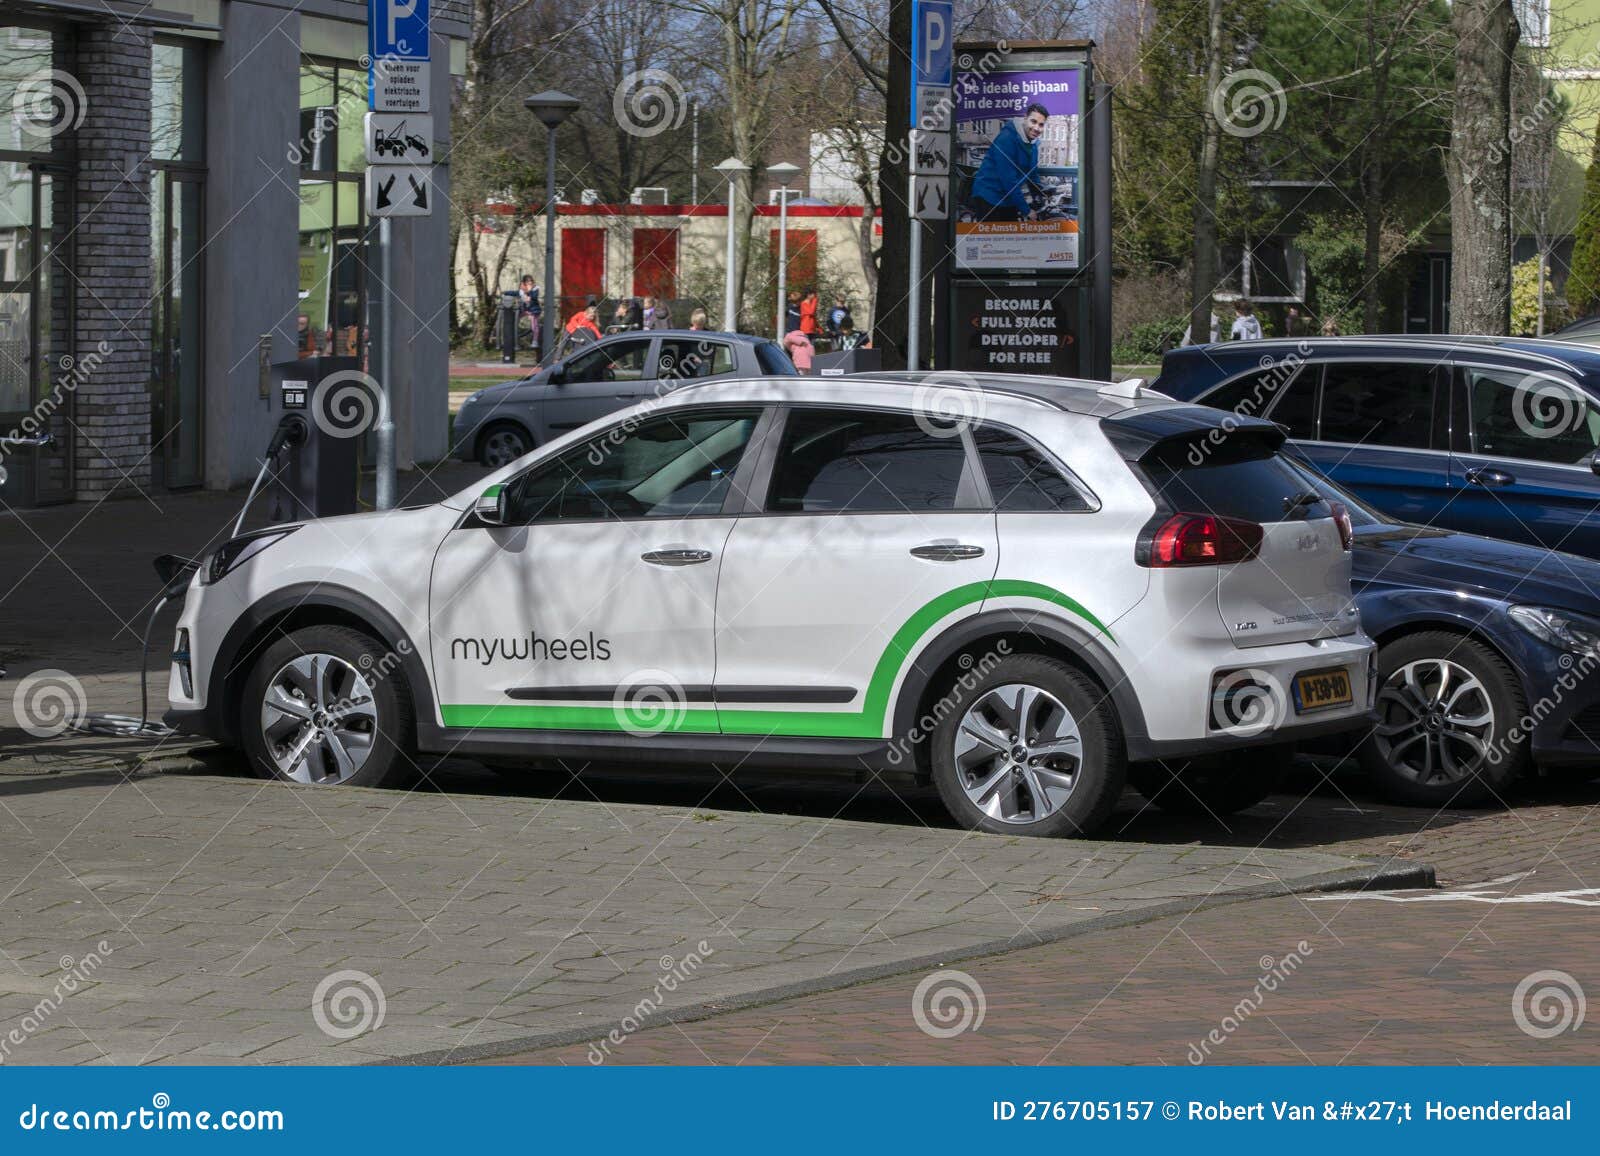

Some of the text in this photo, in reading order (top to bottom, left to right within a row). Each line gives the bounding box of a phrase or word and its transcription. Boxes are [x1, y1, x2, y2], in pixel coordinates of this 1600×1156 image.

[387, 0, 417, 45] P
[926, 11, 945, 73] P
[964, 80, 1069, 95] De ideale bijbaan
[964, 96, 1029, 111] in de zorg?
[978, 224, 991, 232] De
[991, 223, 1018, 232] Amsta
[985, 299, 1053, 311] BECOME A
[981, 317, 1012, 328] FULL
[1015, 317, 1057, 328] STACK
[981, 334, 1058, 346] DEVELOPER
[989, 352, 1052, 363] FOR FREE
[451, 630, 612, 666] mywheels
